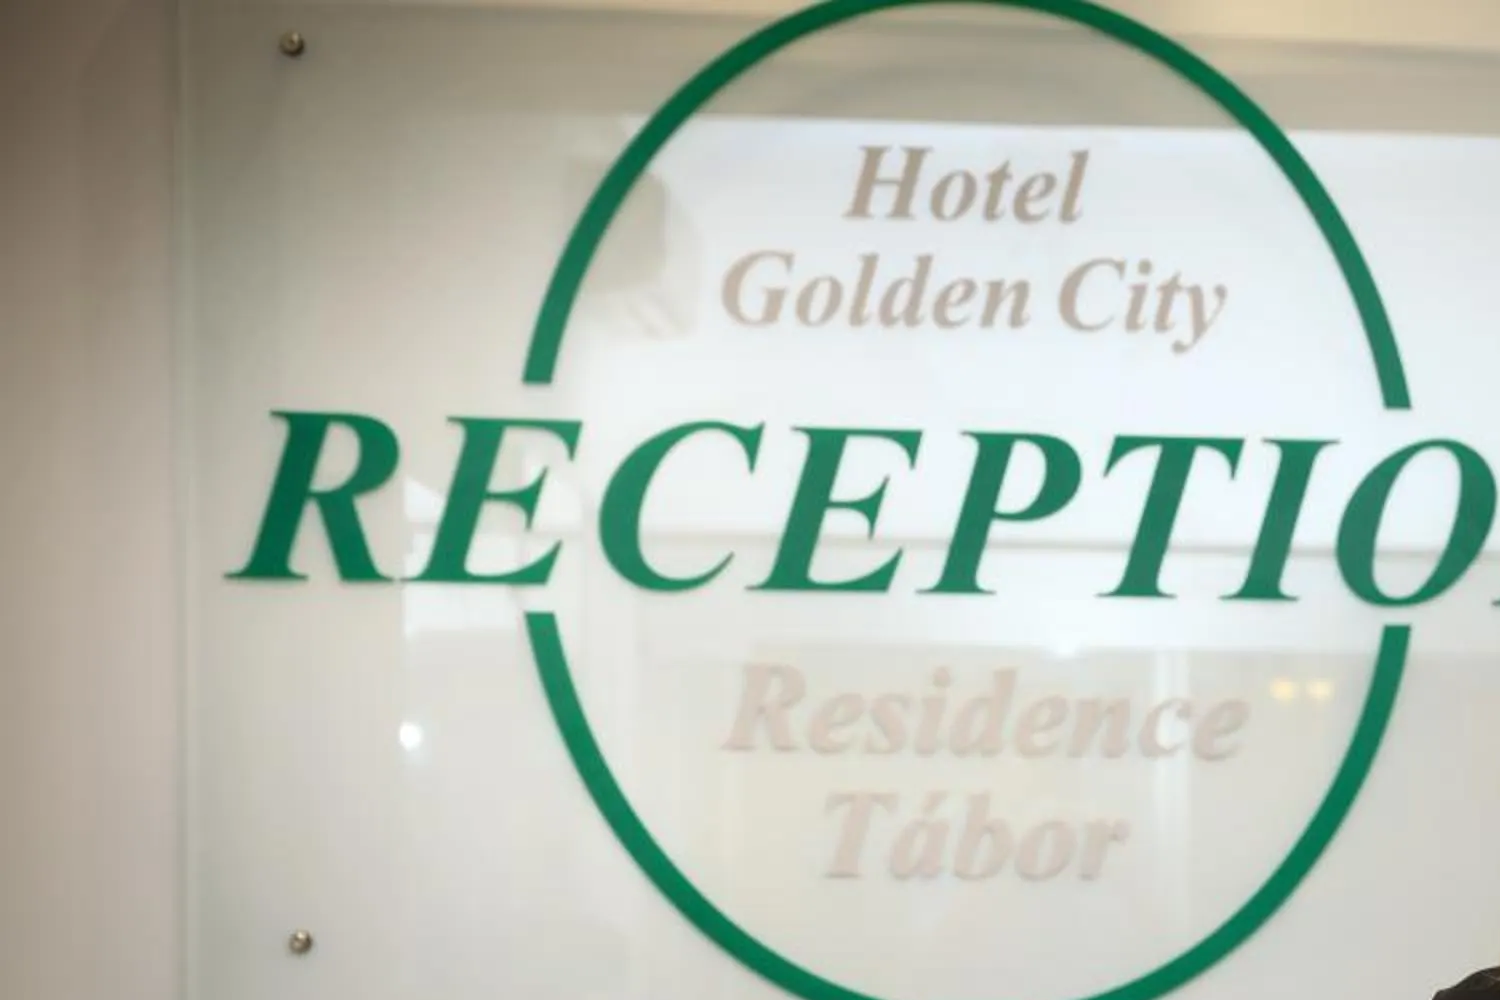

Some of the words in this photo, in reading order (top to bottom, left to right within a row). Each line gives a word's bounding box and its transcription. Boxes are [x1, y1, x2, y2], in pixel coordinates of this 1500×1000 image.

[843, 144, 1090, 224] Hotel
[721, 249, 1031, 331] Golden
[1058, 257, 1228, 354] City
[719, 661, 1252, 762] Residence
[822, 790, 1130, 881] Tábor
